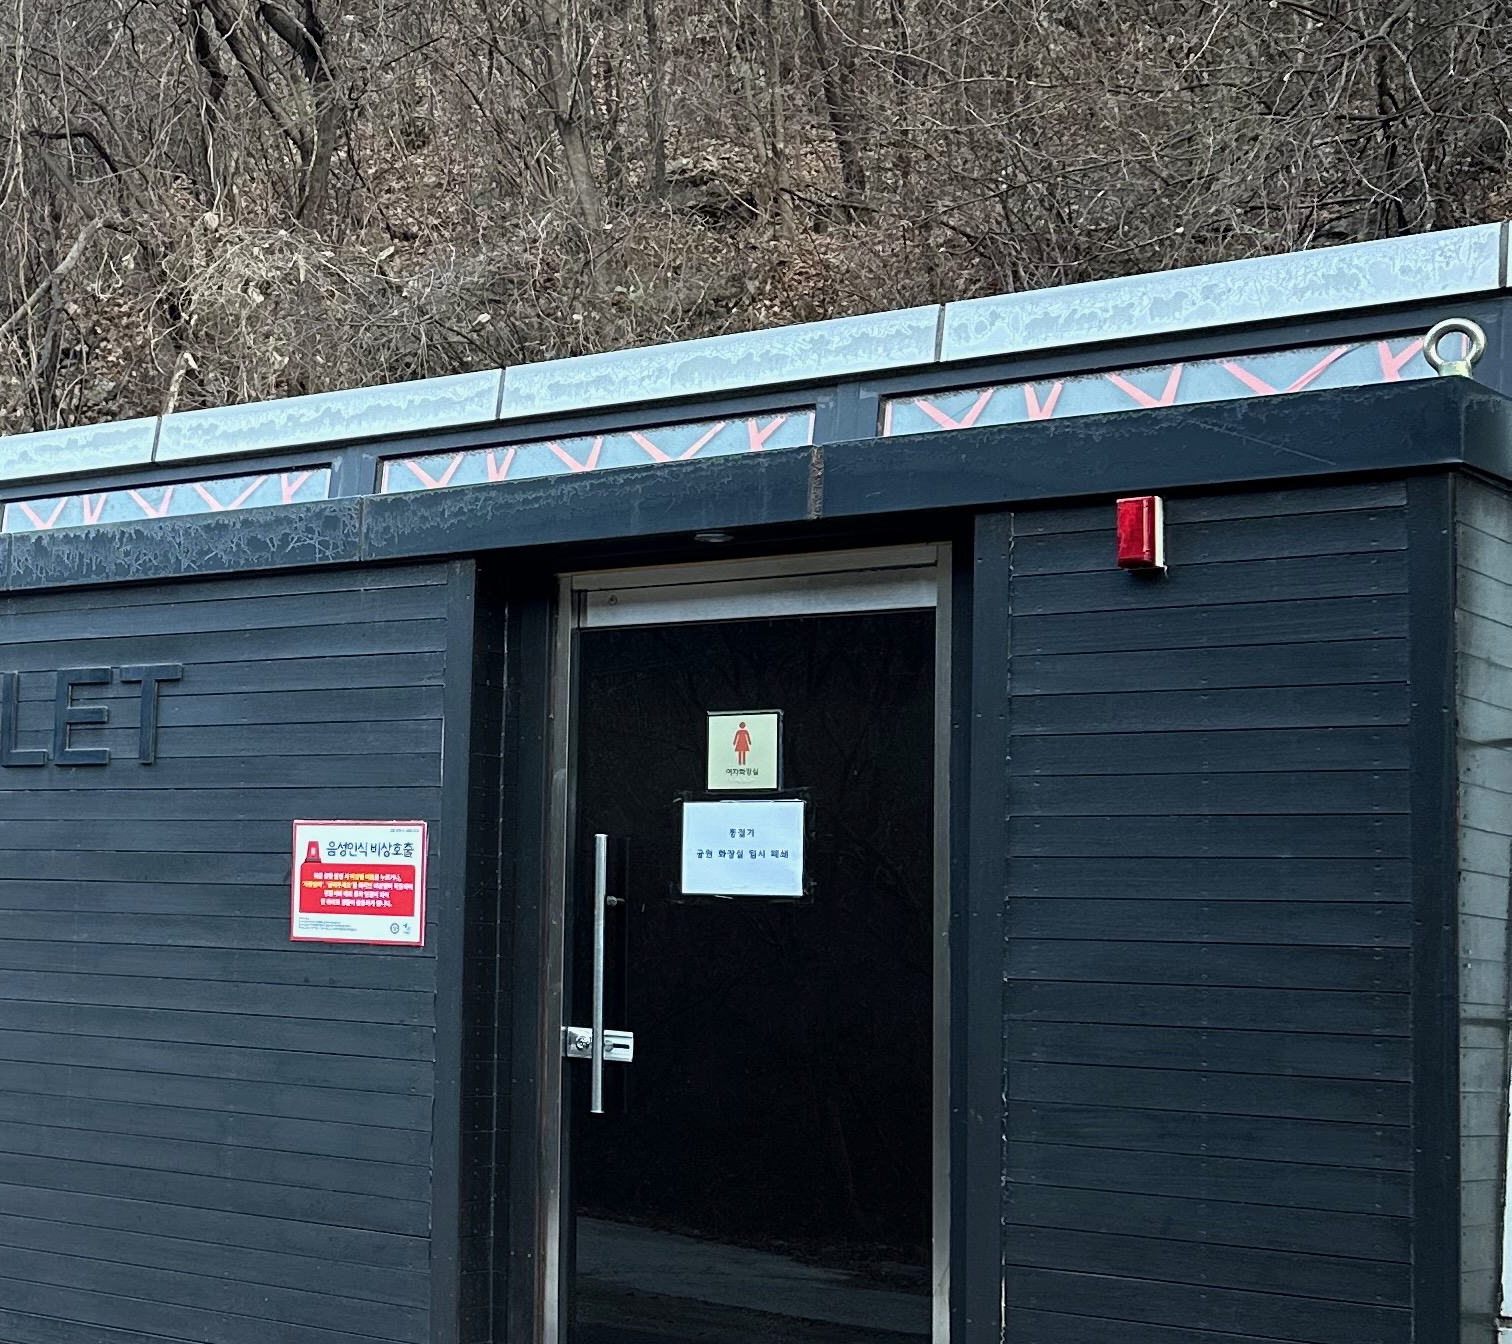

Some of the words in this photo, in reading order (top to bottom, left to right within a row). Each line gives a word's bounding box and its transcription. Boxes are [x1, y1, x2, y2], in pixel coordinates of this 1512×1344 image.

[725, 768, 759, 776] 여자화장실
[326, 841, 368, 857] 음성인식
[370, 842, 414, 858] 비상호출
[718, 849, 744, 859] 화장실
[748, 849, 766, 860] 임시
